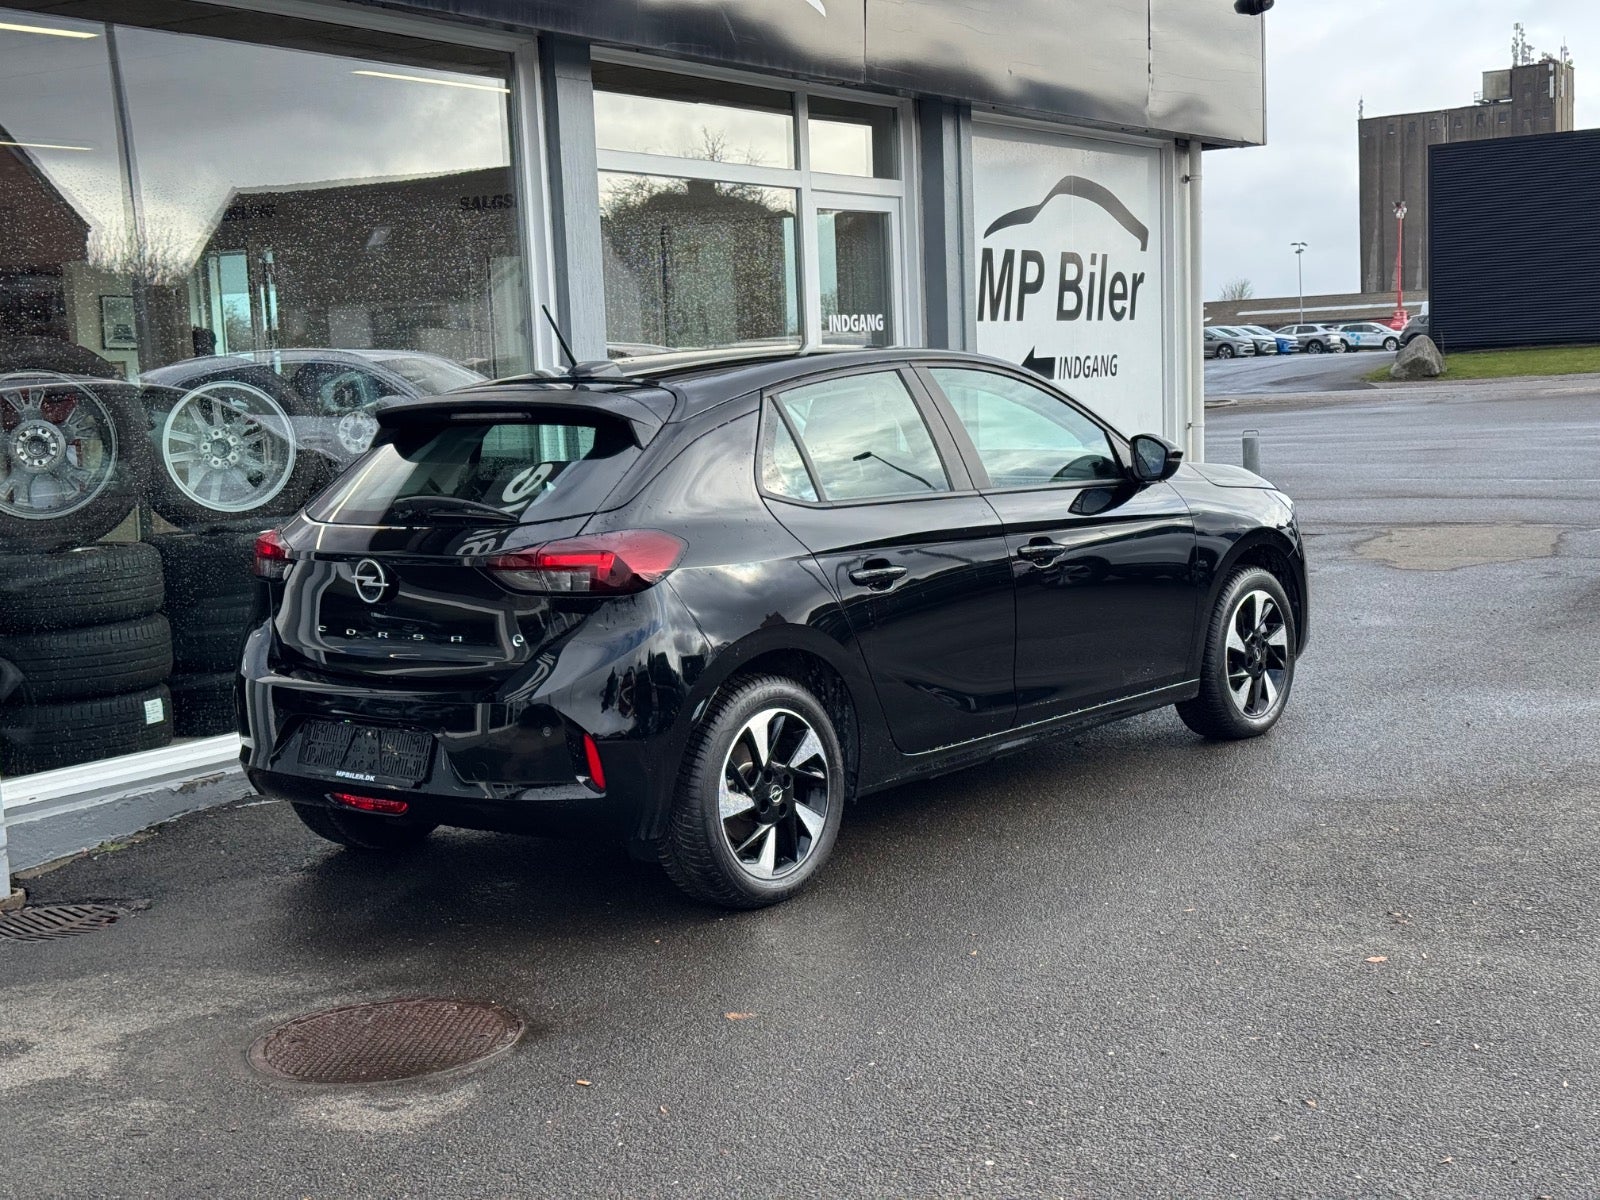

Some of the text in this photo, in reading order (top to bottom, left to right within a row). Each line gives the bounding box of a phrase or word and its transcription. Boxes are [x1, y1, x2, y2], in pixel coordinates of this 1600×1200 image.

[460, 192, 518, 211] SALGS
[977, 247, 1145, 322] MP Biler
[829, 313, 884, 332] INDGANG
[1059, 354, 1118, 380] INDGANG
[317, 625, 462, 643] CORSA
[335, 770, 376, 782] MPBILER.DK
